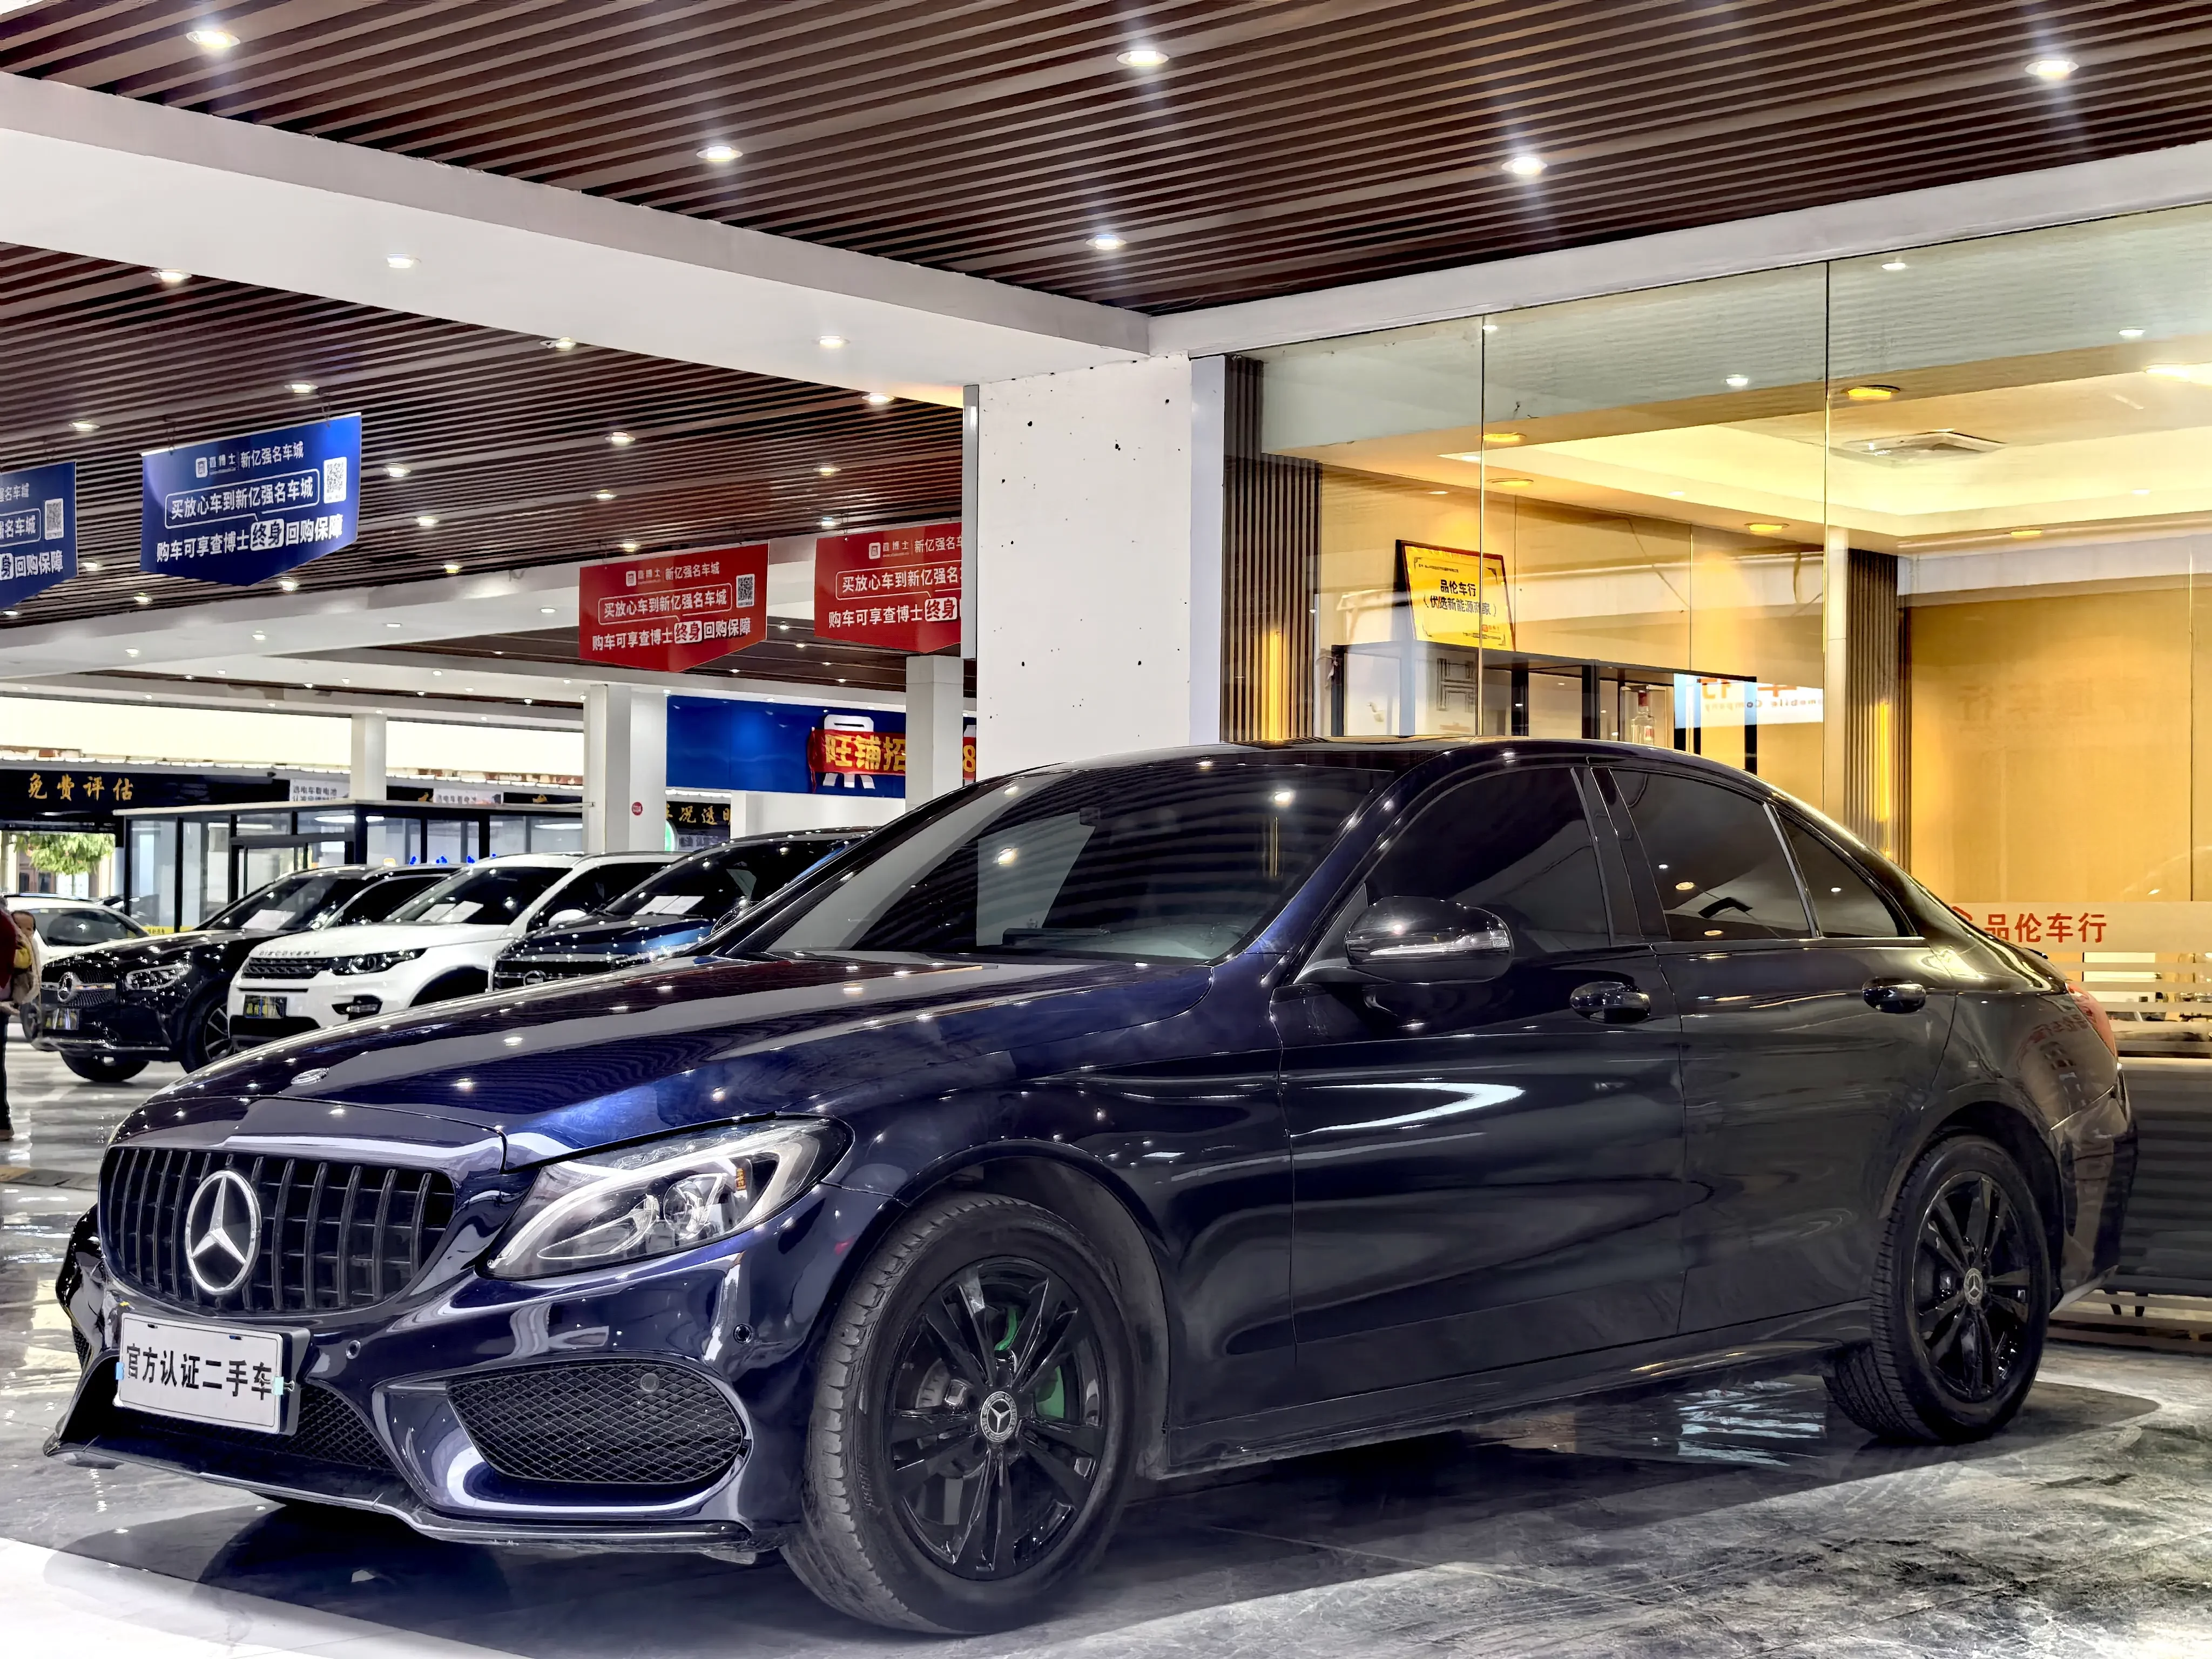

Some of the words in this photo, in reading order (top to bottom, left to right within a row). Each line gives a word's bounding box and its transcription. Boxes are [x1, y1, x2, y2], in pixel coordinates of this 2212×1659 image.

[240, 441, 304, 468] 新亿强名车城
[171, 476, 313, 521] 买放心车到新亿强名车城
[157, 514, 343, 563] 购车可享查博士终身回购保障
[665, 561, 720, 581] 新亿强名车城
[842, 566, 962, 594] 买放心车到新亿强名
[1440, 579, 1476, 596] 品伦车行
[604, 589, 727, 619] 买放心车到新亿强名车城
[828, 597, 961, 629] 购车可享查博士终身
[592, 617, 751, 651] 购车可享查博士终身回购保障
[1985, 912, 2107, 943] 品伦车行
[126, 1343, 272, 1400] 官方认证二手车
